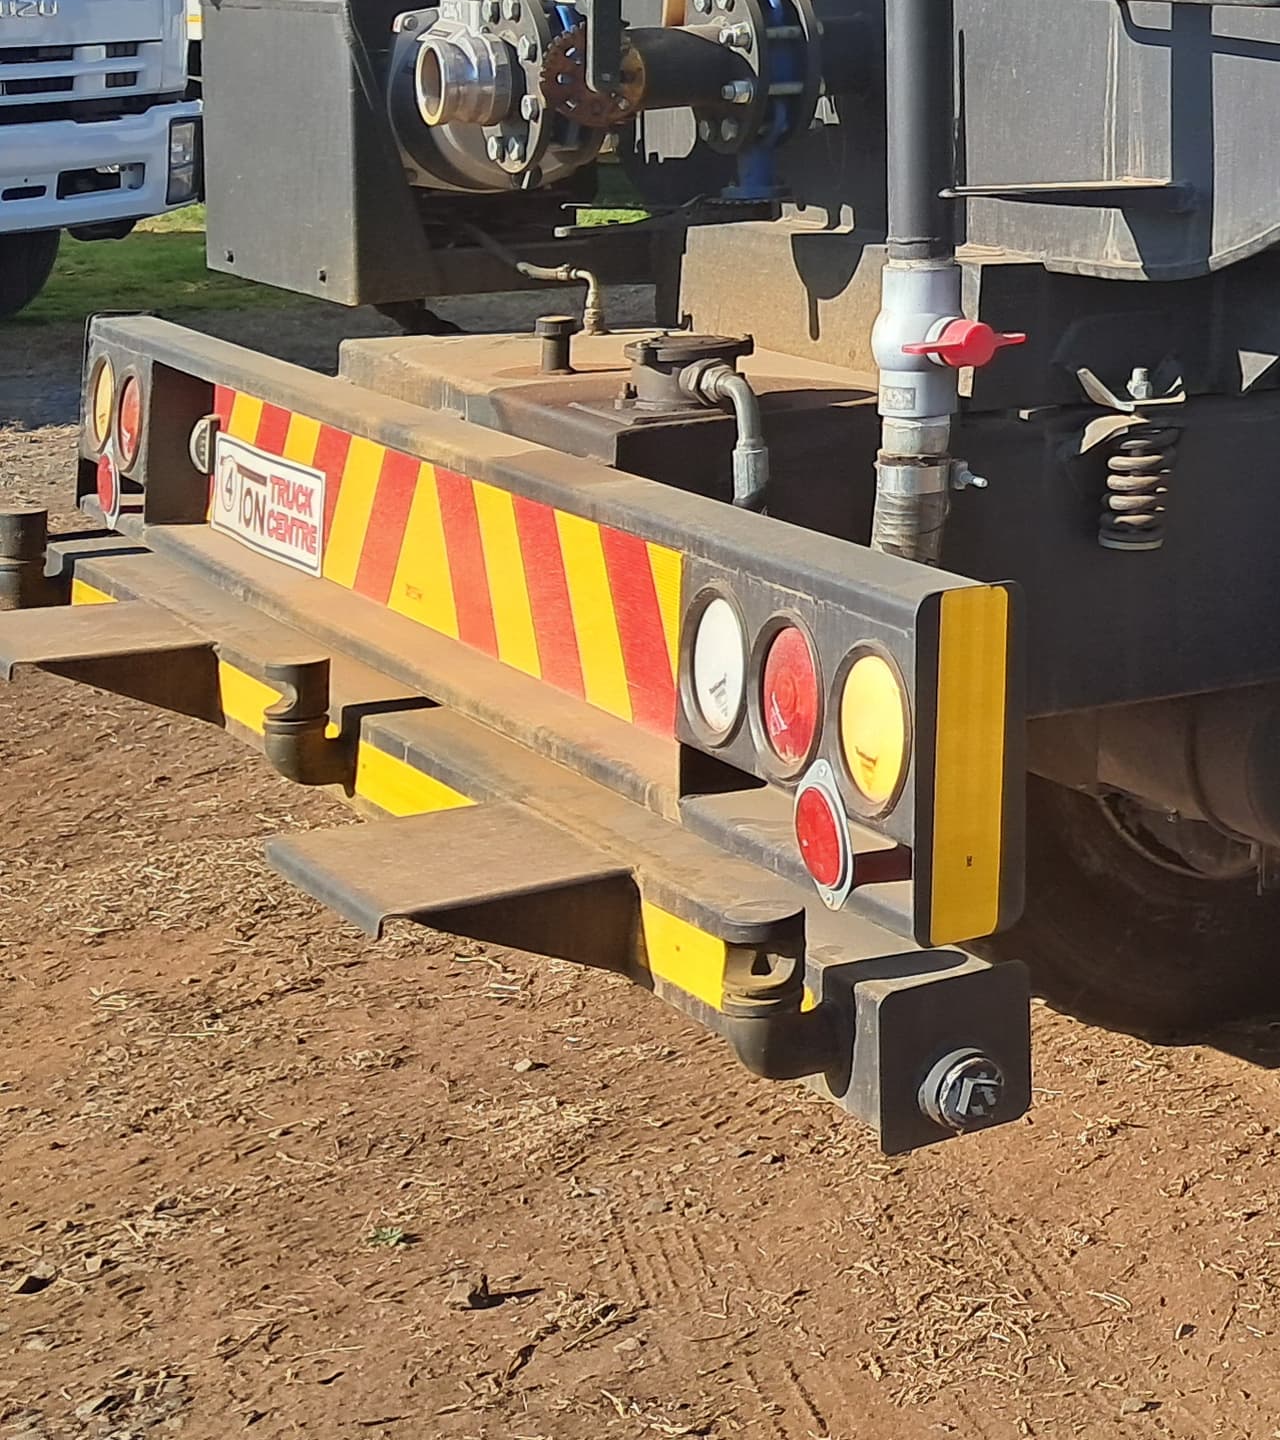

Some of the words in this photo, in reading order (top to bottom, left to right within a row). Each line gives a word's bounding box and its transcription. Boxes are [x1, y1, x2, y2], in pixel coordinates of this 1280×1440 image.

[236, 462, 267, 537] TON
[269, 473, 315, 519] TRUCK
[267, 508, 318, 556] CENTRE
